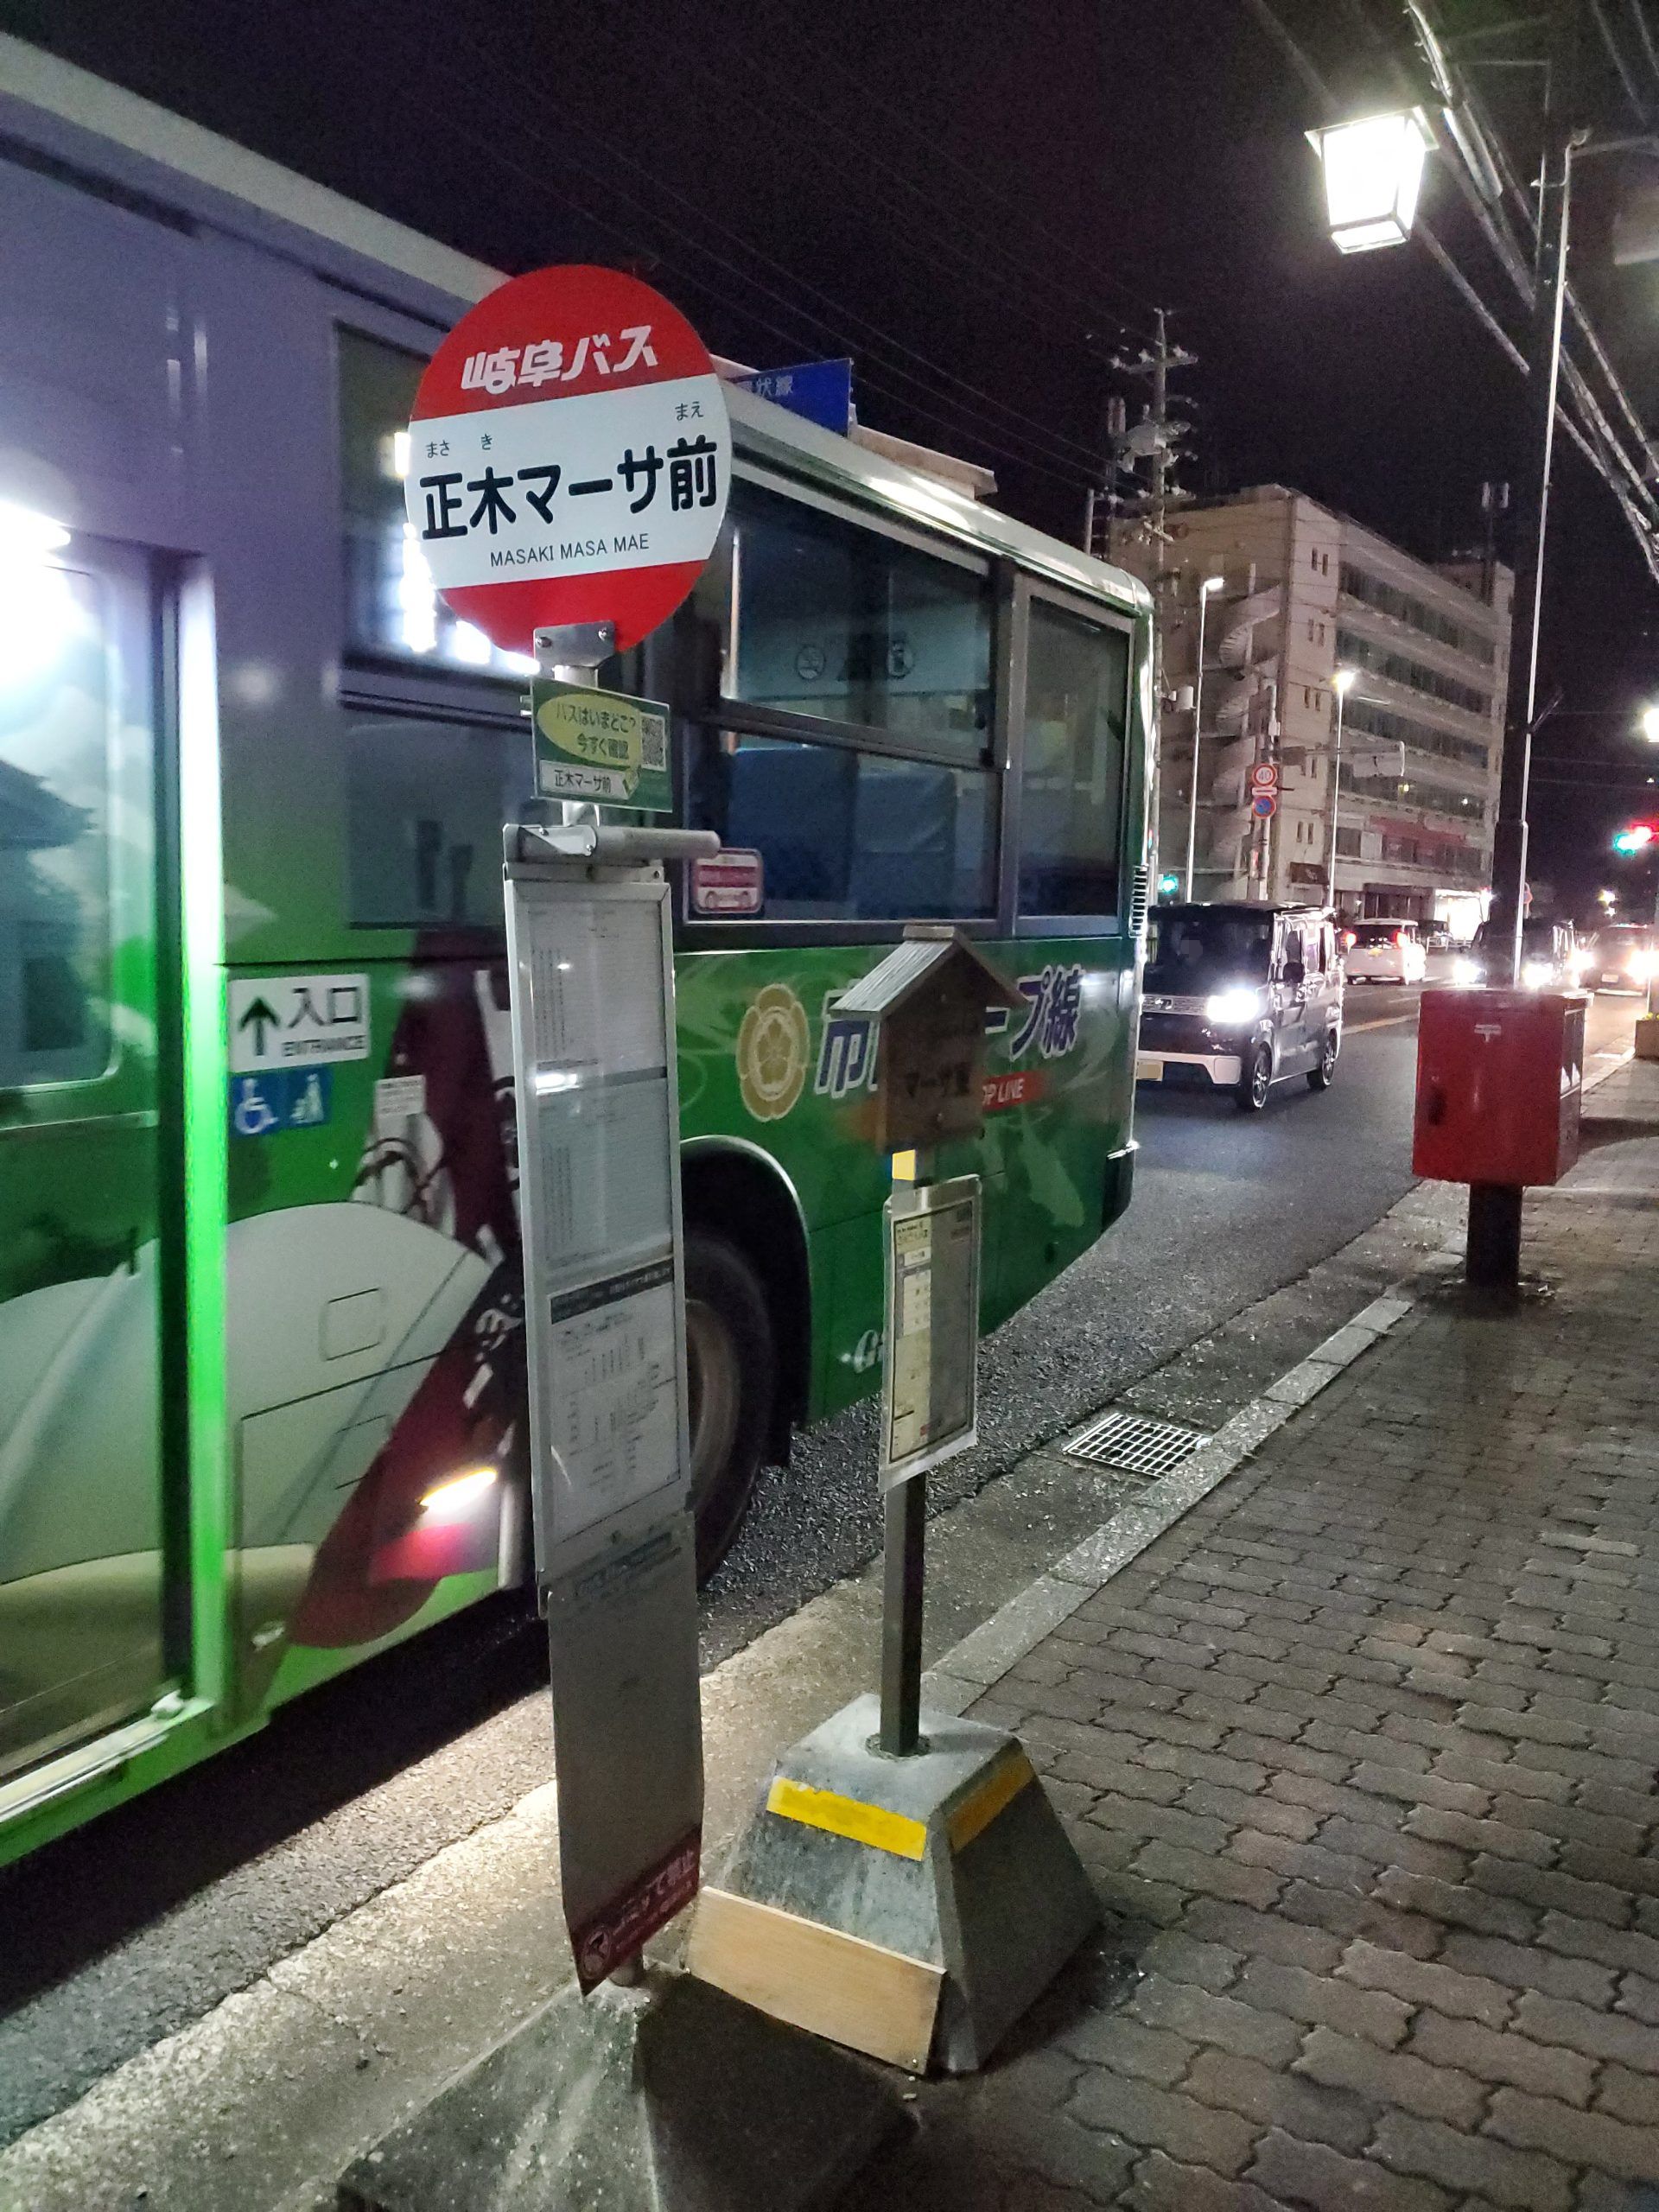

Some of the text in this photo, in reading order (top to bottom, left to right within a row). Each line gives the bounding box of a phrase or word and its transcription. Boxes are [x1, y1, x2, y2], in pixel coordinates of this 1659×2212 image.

[461, 325, 658, 395] 岐阜バス
[426, 401, 704, 459] まさ き まえ
[420, 434, 717, 541] 正木マーサ前
[490, 533, 650, 568] MASAKI MASA MAE
[554, 769, 612, 793] 正木マーサ前
[288, 987, 361, 1028] 入口
[997, 1078, 1025, 1103] LINE
